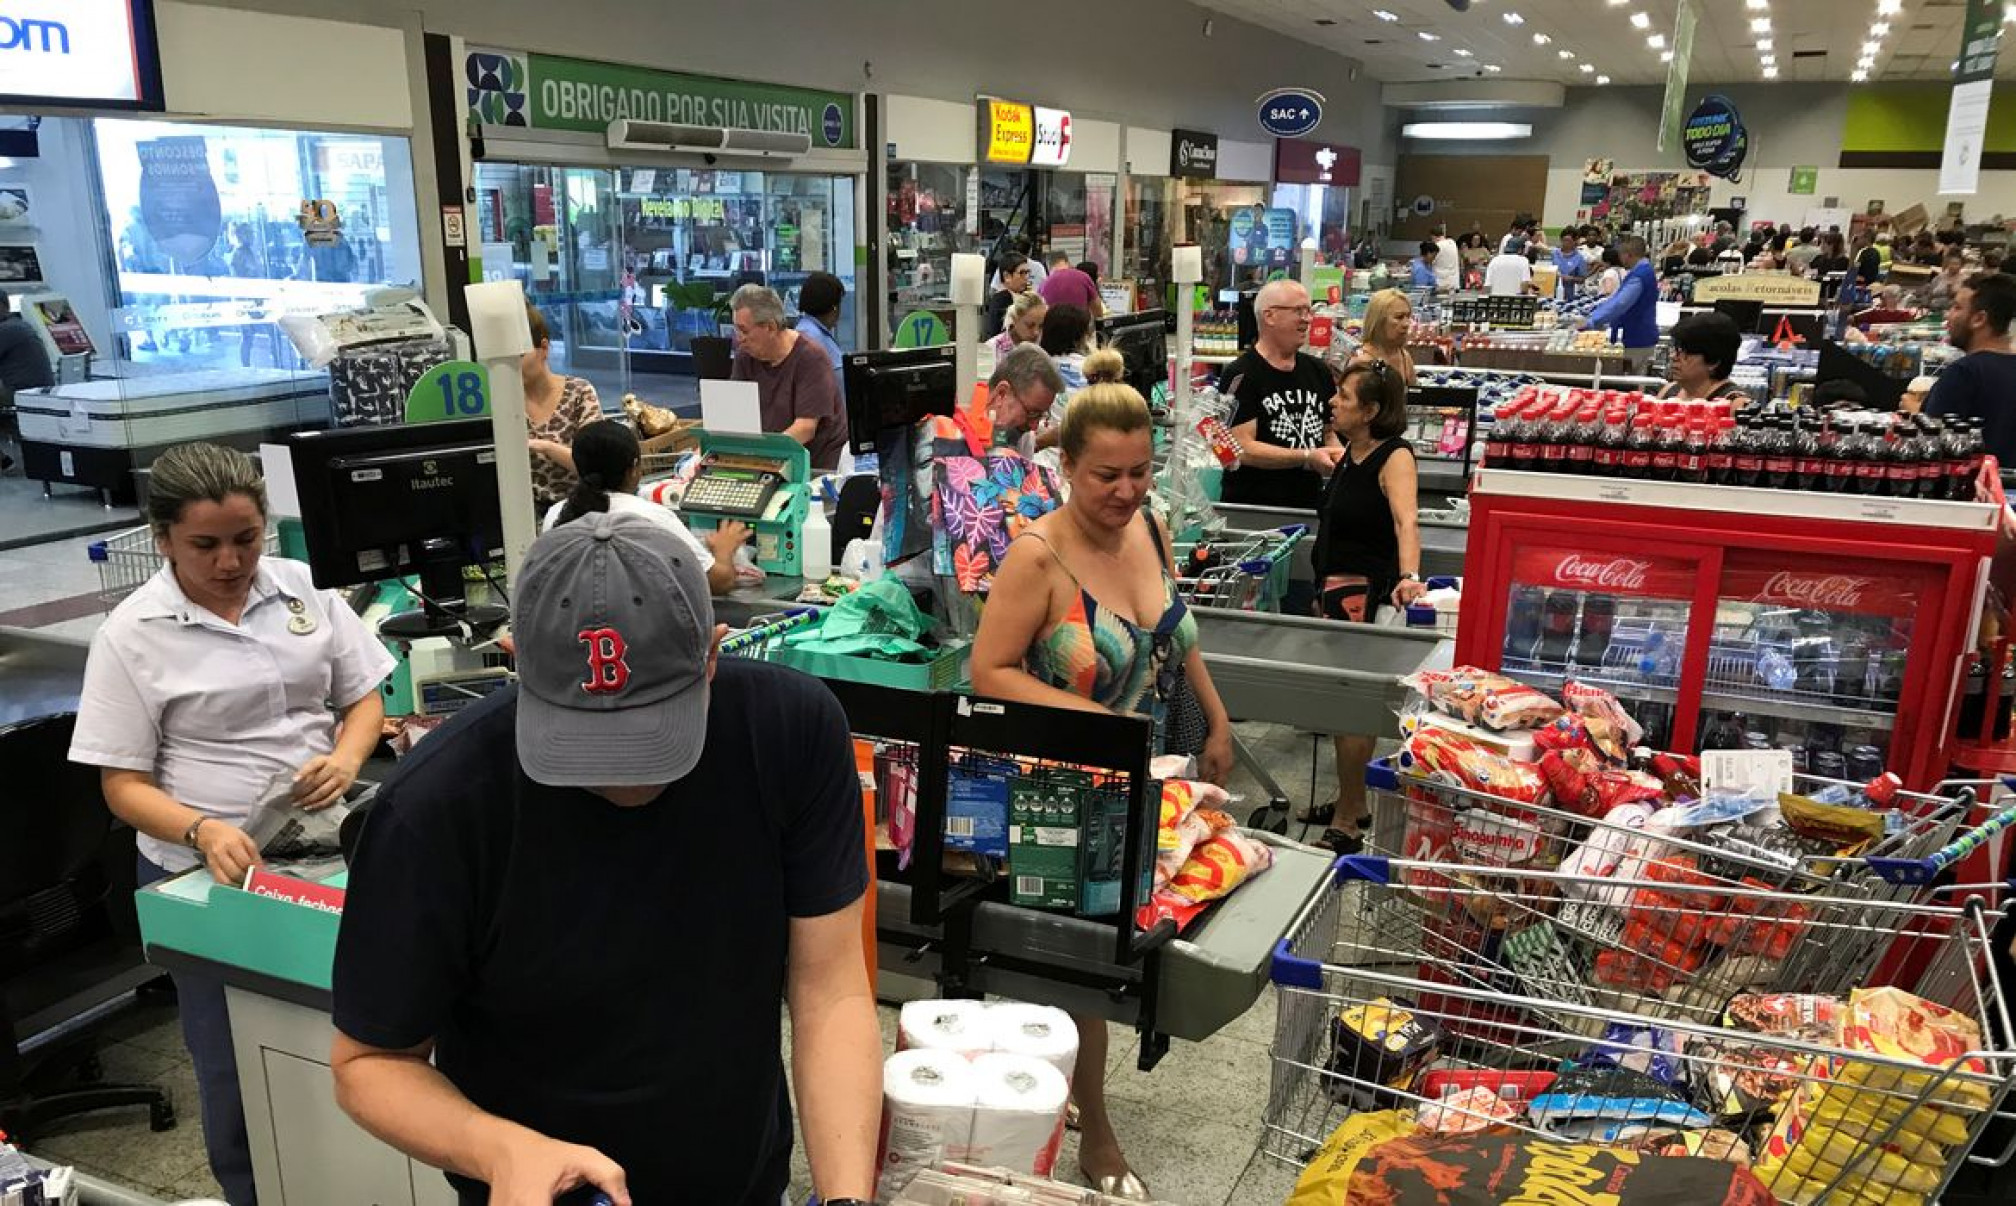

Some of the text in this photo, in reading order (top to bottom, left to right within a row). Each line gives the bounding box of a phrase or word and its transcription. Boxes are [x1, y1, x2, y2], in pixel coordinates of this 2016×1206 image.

[542, 79, 813, 135] OBRIGADO POR SUA VISITA!
[1270, 107, 1296, 120] SAC
[996, 124, 1027, 145] Express
[913, 317, 934, 346] 17
[437, 371, 485, 415] 18
[411, 476, 454, 491] Itautec
[578, 628, 632, 693] B
